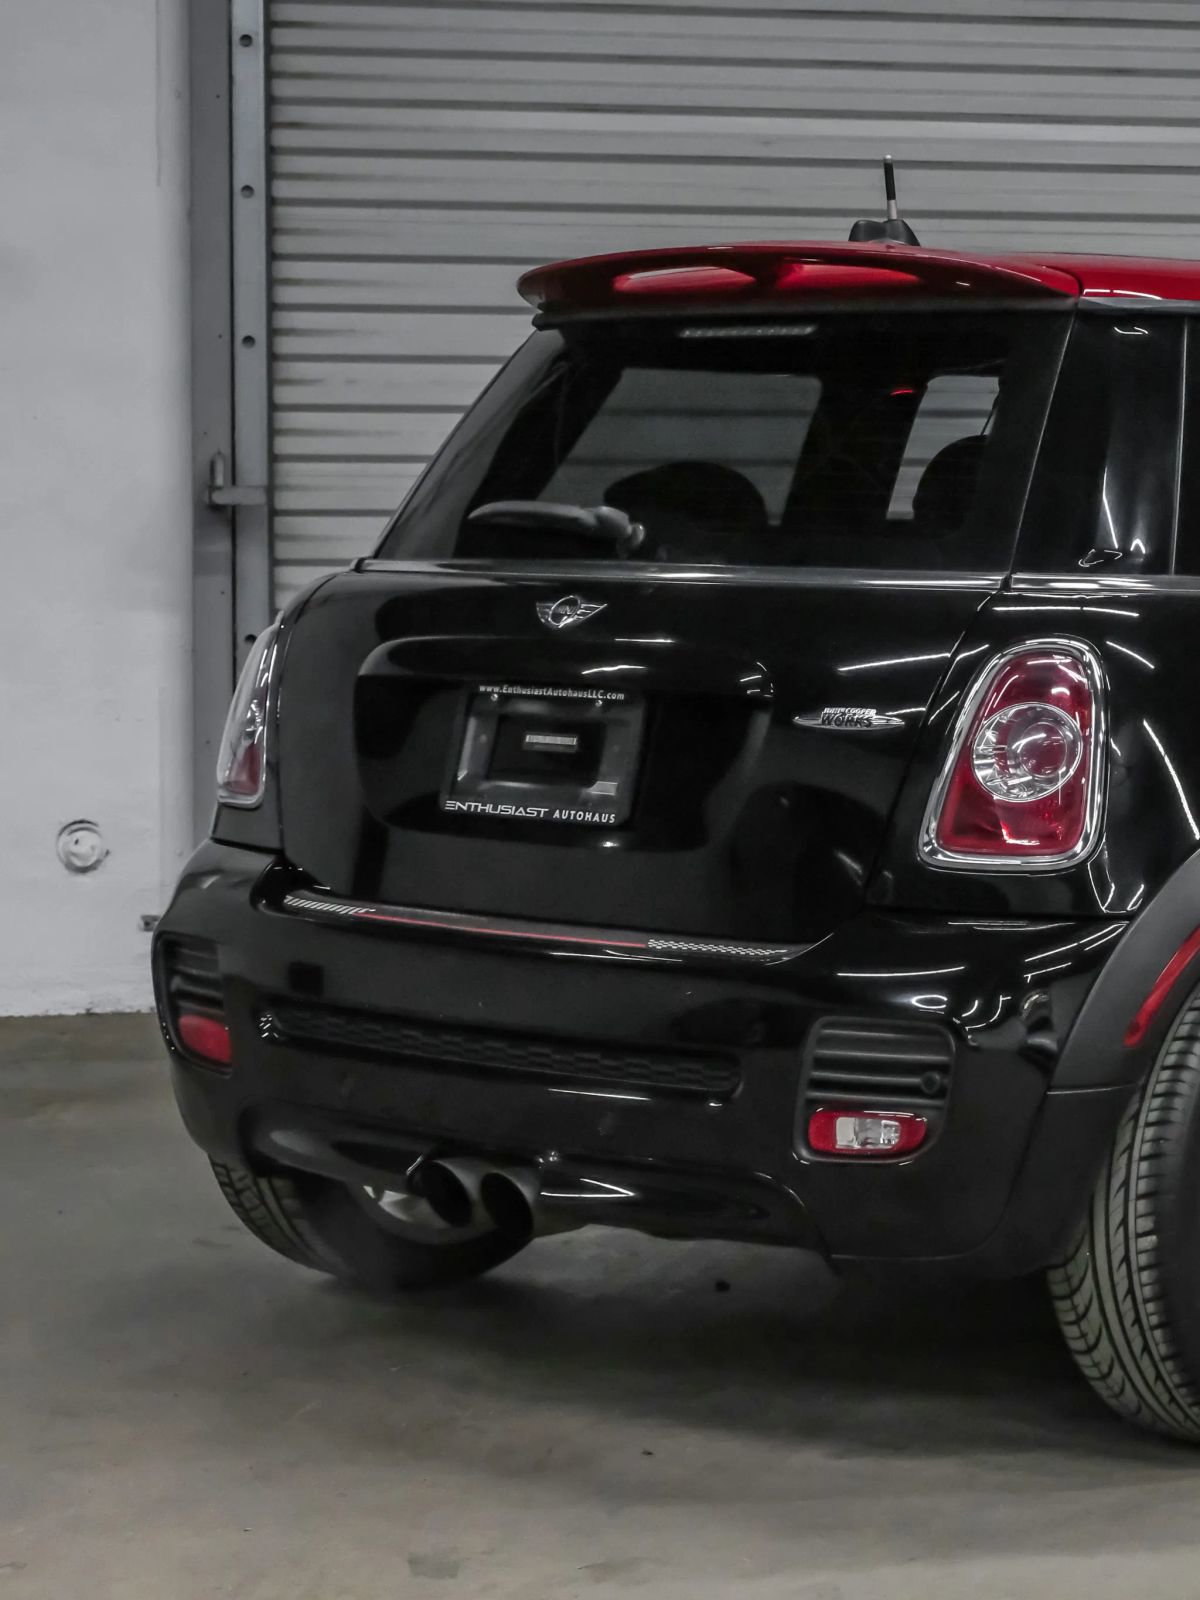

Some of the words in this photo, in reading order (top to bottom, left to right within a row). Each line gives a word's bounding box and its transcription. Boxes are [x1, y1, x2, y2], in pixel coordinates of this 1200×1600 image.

[479, 684, 625, 700] www.EnthusiastAutohausLLC.com
[445, 800, 549, 818] ENTHUSIAST
[553, 809, 616, 824] AUTOHAUS
